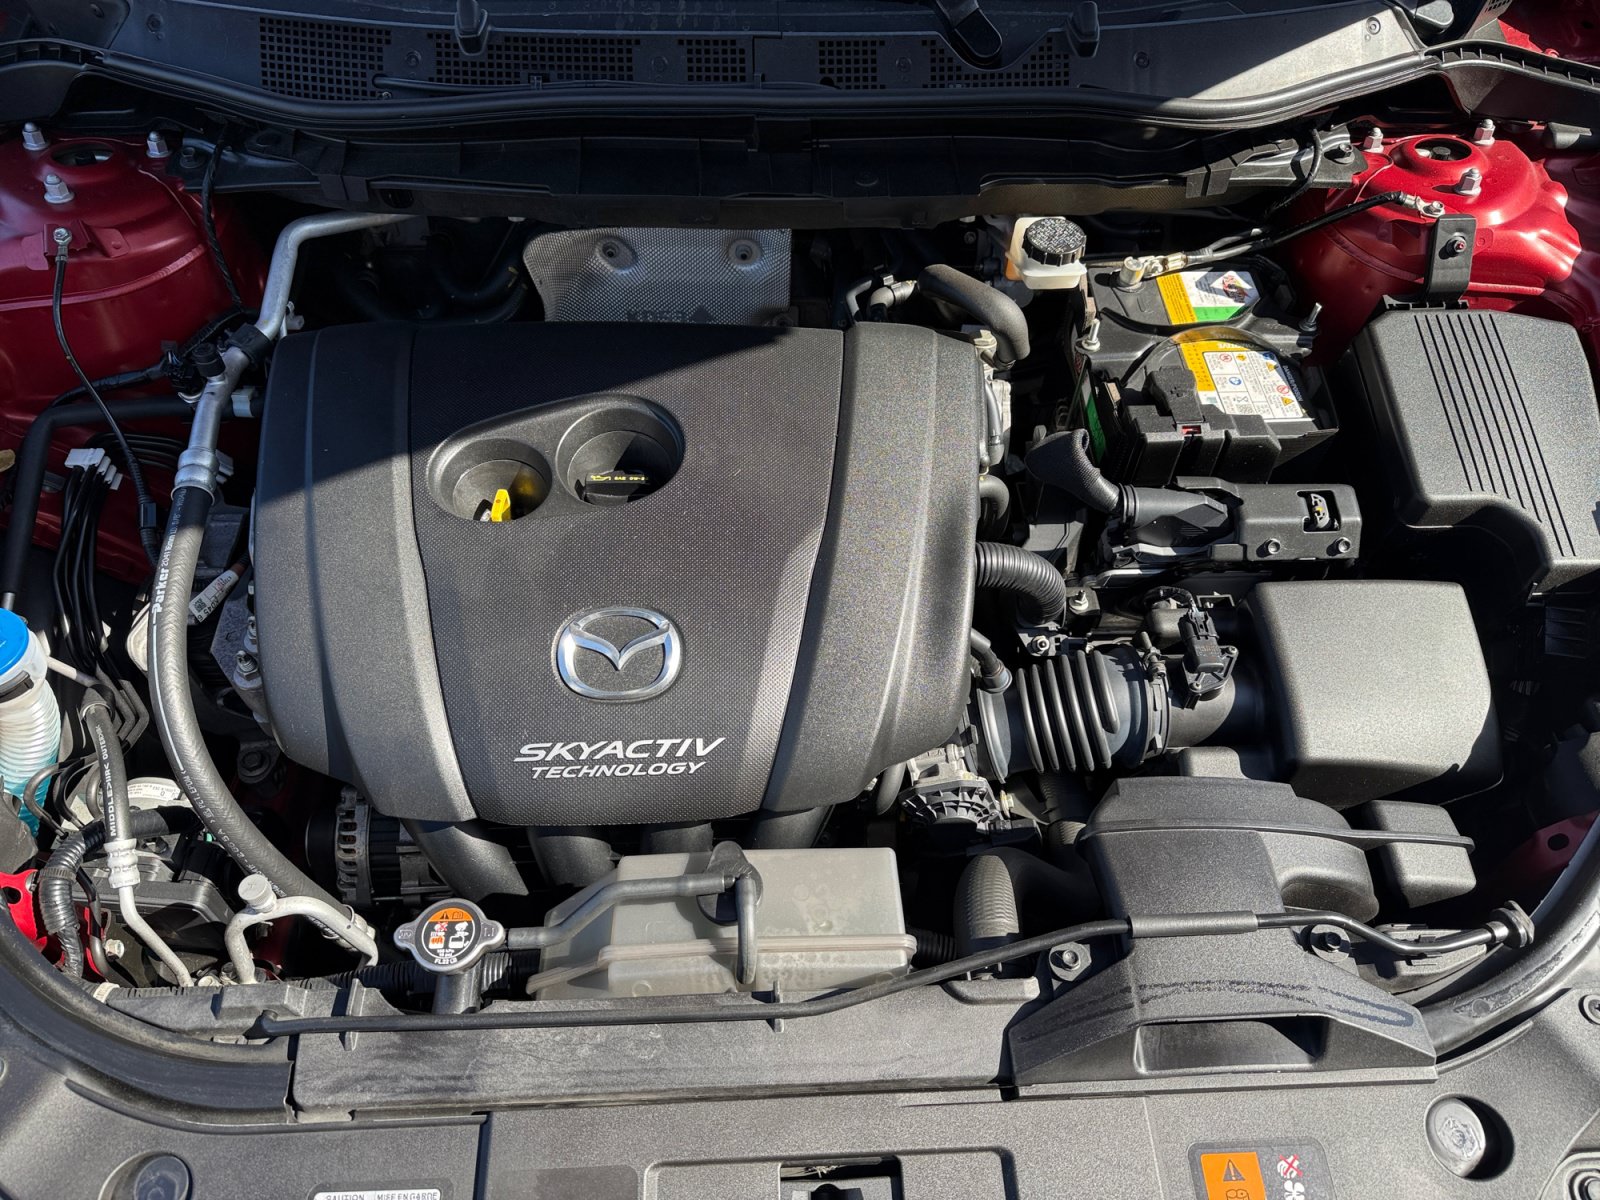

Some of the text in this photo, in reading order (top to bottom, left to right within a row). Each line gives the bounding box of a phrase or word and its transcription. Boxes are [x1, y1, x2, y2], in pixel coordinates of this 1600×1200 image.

[152, 568, 169, 613] Parker
[513, 737, 727, 763] SKYACTIV
[531, 761, 707, 779] TECHNOLOGY
